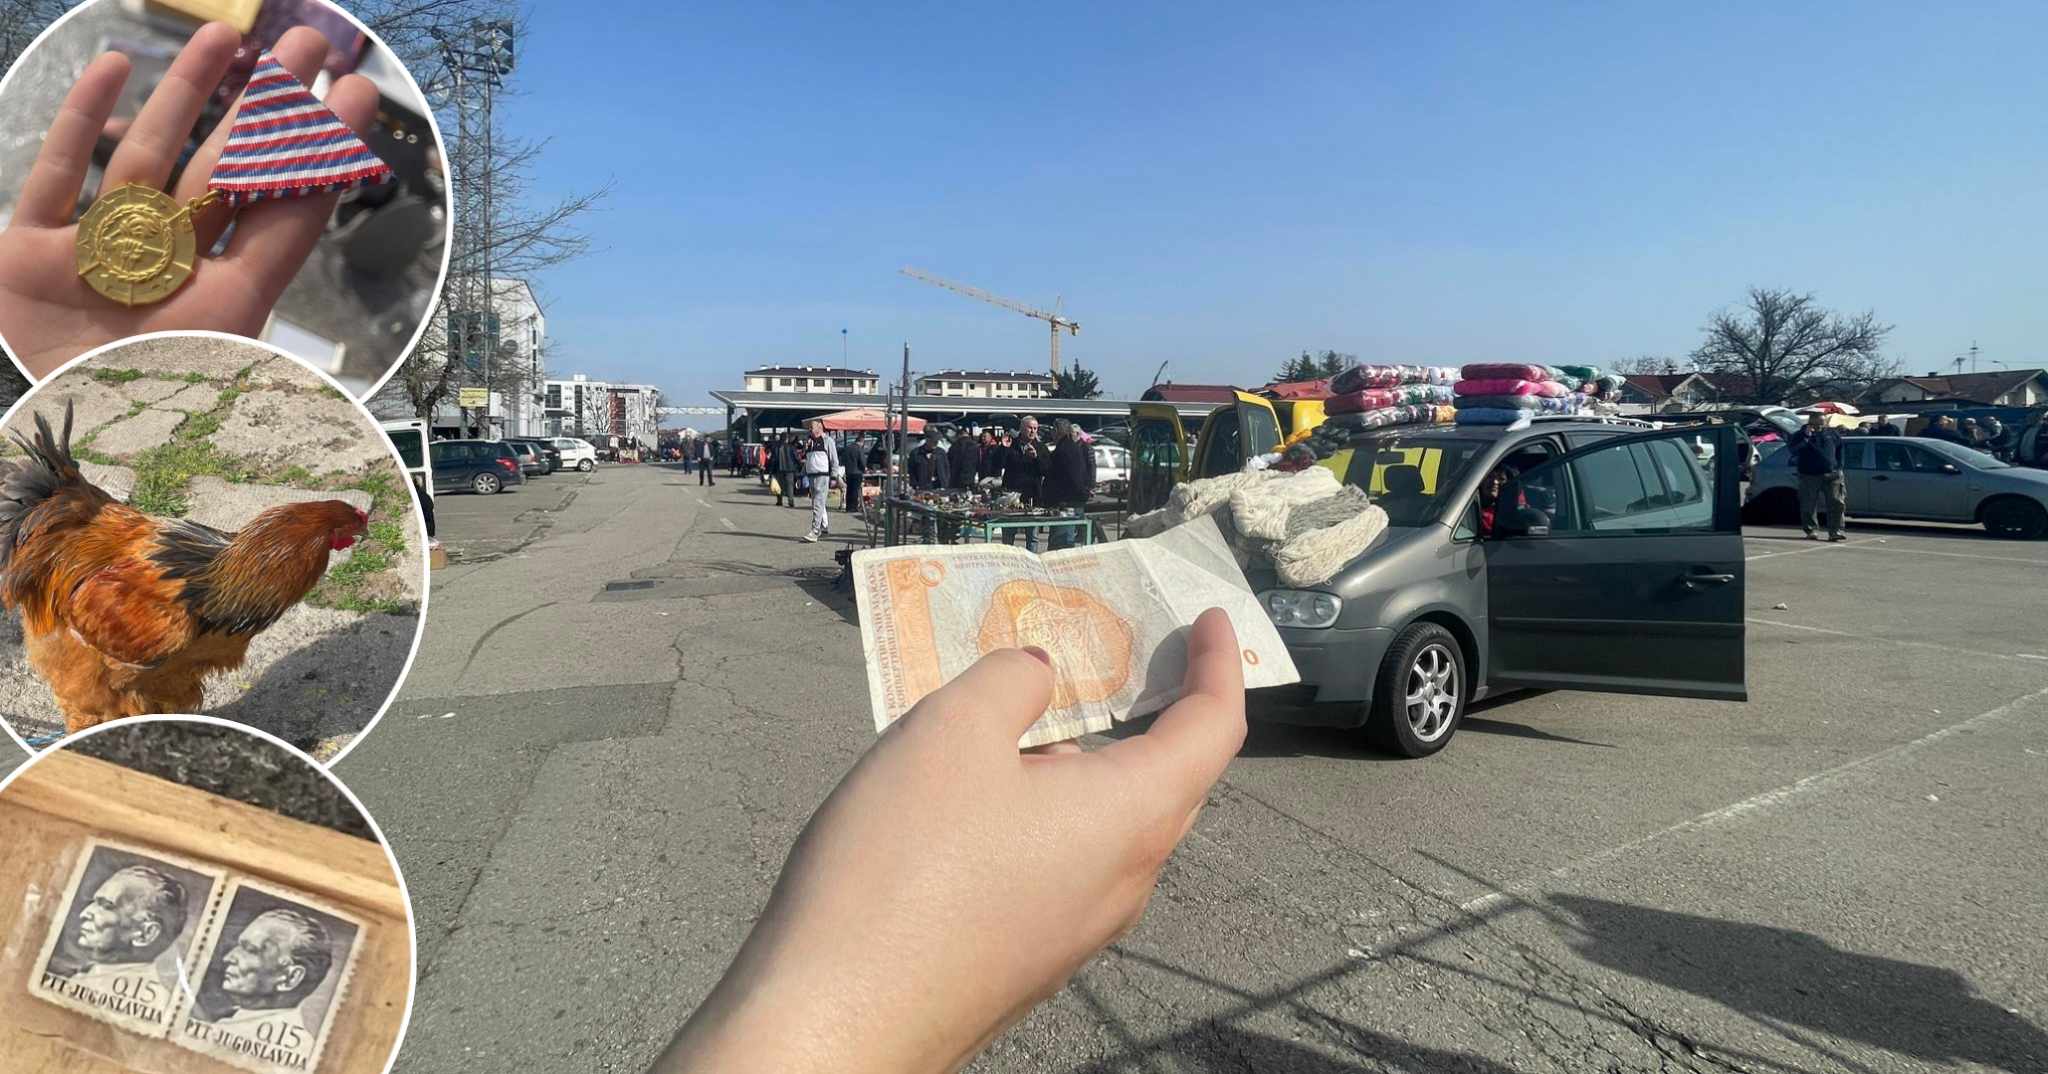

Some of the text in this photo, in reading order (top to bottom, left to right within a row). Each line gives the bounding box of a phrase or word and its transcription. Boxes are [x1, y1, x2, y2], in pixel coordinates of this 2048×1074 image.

[40, 972, 67, 993] PTT
[184, 1019, 306, 1071] PTT JUGOSLAVIJA
